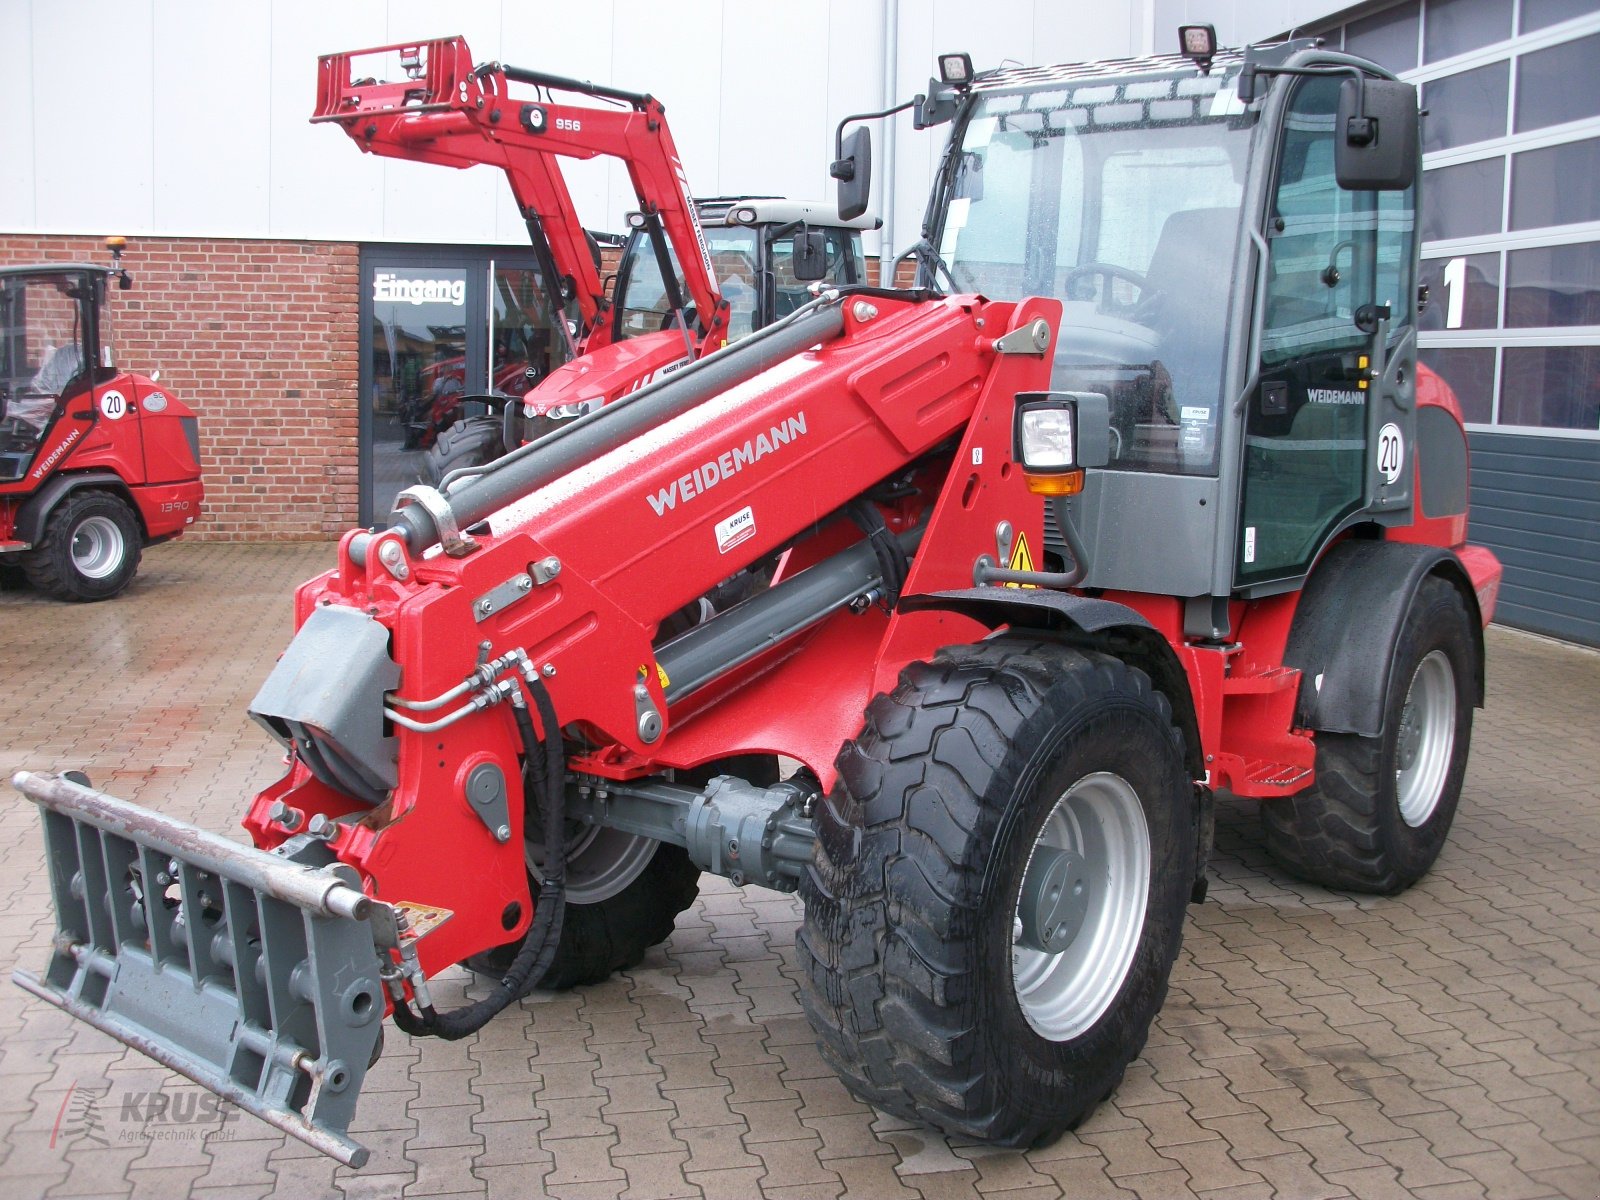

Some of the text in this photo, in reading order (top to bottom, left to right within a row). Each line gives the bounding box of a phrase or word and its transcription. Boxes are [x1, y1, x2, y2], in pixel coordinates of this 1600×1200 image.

[555, 118, 581, 132] 956
[686, 195, 711, 271] MASSEY FERGUSON
[373, 273, 466, 306] Eingang
[1443, 257, 1466, 329] 1
[662, 364, 679, 374] MASSEY
[105, 395, 121, 414] 20
[1307, 388, 1365, 405] WEIDEMANN
[32, 428, 81, 479] WEIDEMANN
[646, 411, 808, 517] WEIDEMANN
[1381, 435, 1398, 472] 20
[160, 501, 190, 513] 1390
[729, 511, 751, 529] KRUSE
